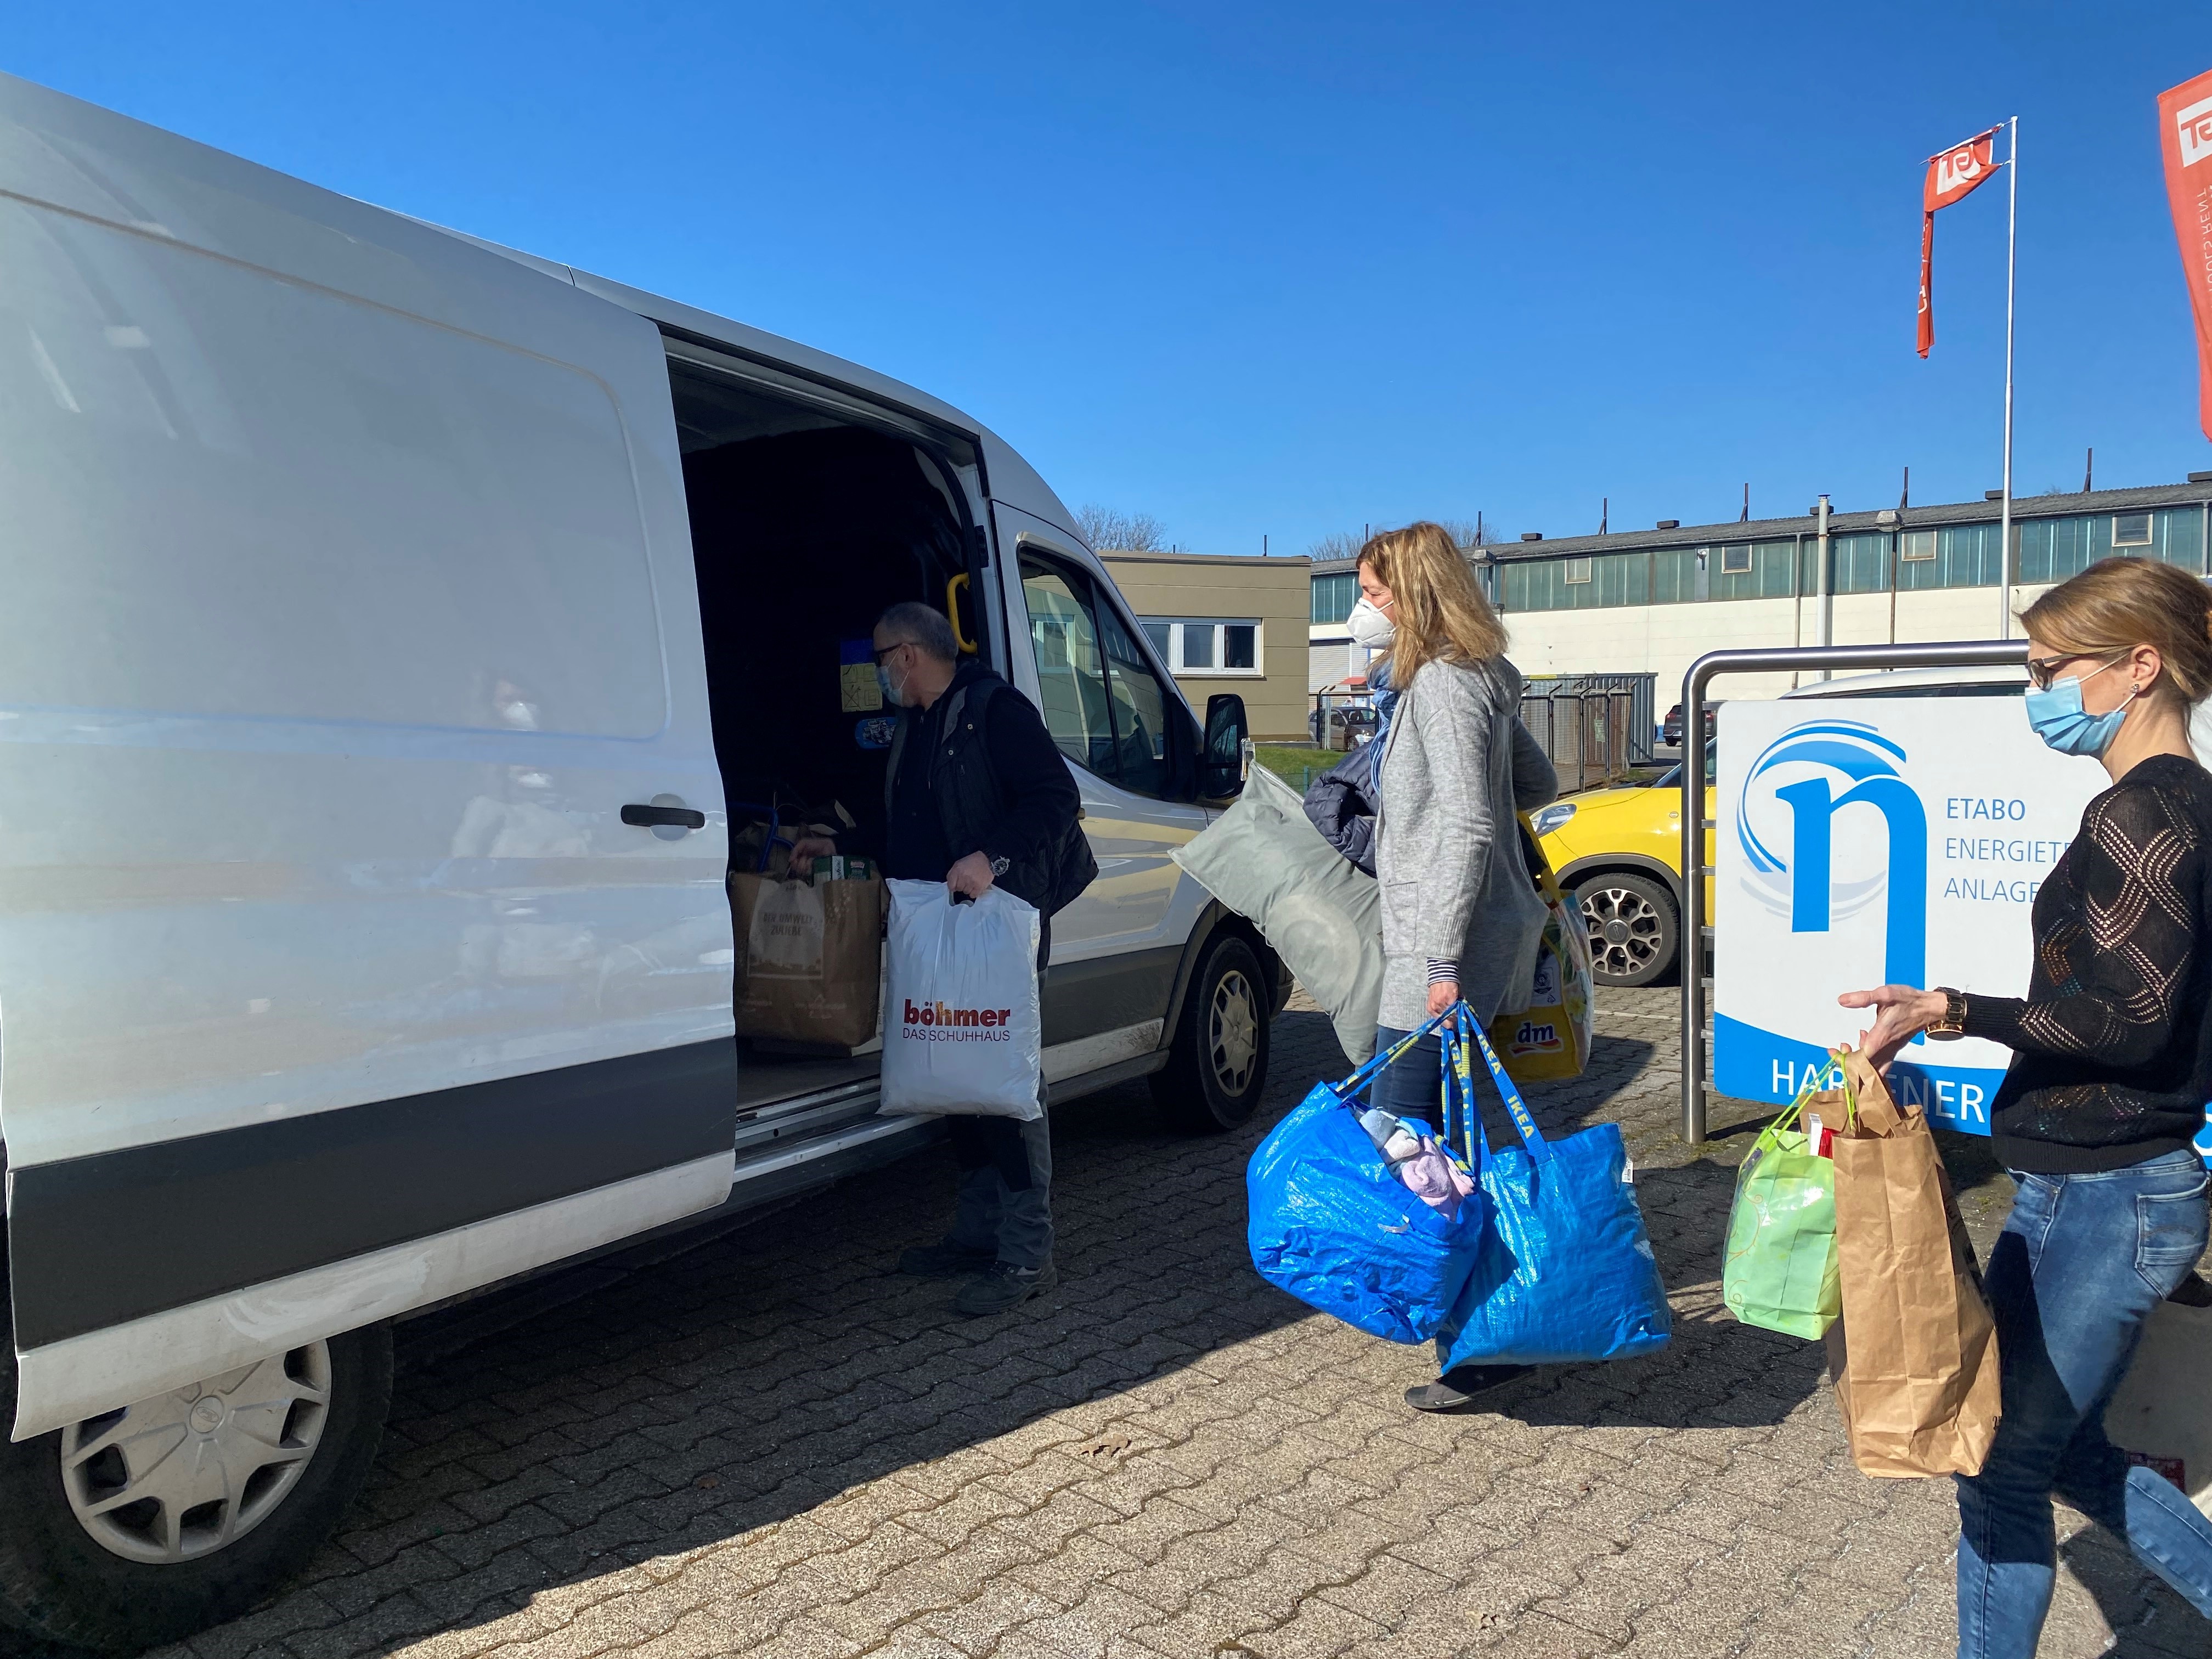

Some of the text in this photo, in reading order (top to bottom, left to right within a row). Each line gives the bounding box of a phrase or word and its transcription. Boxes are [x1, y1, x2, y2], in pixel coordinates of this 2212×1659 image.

[1946, 798, 2026, 821] ETABO
[1946, 838, 2072, 863] ENERGIET
[904, 998, 1011, 1027] böhmer
[902, 1028, 1011, 1042] DAS SCHUHHAUS
[1517, 1022, 1554, 1043] dm
[1477, 1034, 1501, 1075] IKEA
[1772, 1058, 1986, 1123] HARNER
[1508, 1094, 1534, 1139] IKEA
